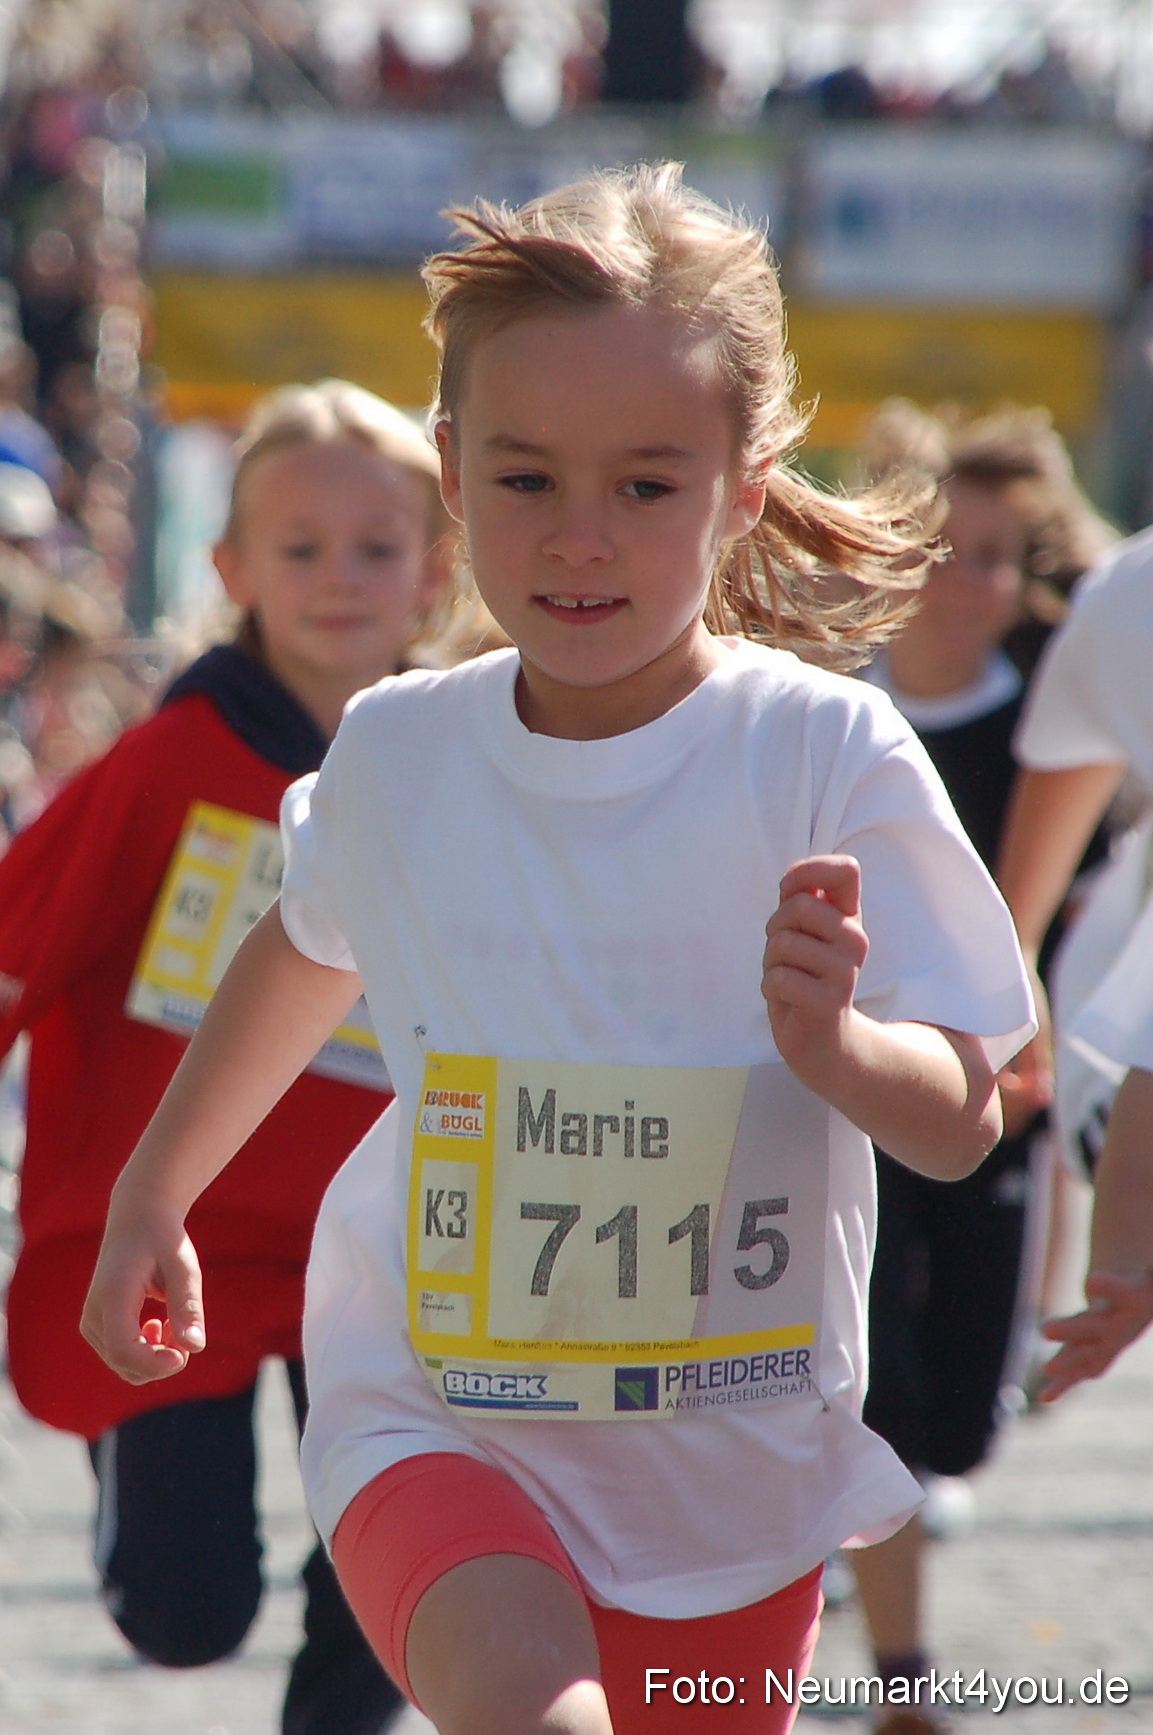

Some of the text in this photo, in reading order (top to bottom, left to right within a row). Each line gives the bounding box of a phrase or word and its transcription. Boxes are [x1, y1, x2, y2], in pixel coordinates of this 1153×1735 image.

[424, 1090, 484, 1109] DRUCK
[420, 1111, 434, 1133] &
[516, 1086, 669, 1159] Marie
[425, 1188, 468, 1238] K3
[520, 1196, 791, 1298] 7115
[443, 1370, 548, 1398] BOCK
[664, 1348, 812, 1392] PFLEIDERER
[664, 1379, 813, 1410] AKTIENGESELLSCHAFT
